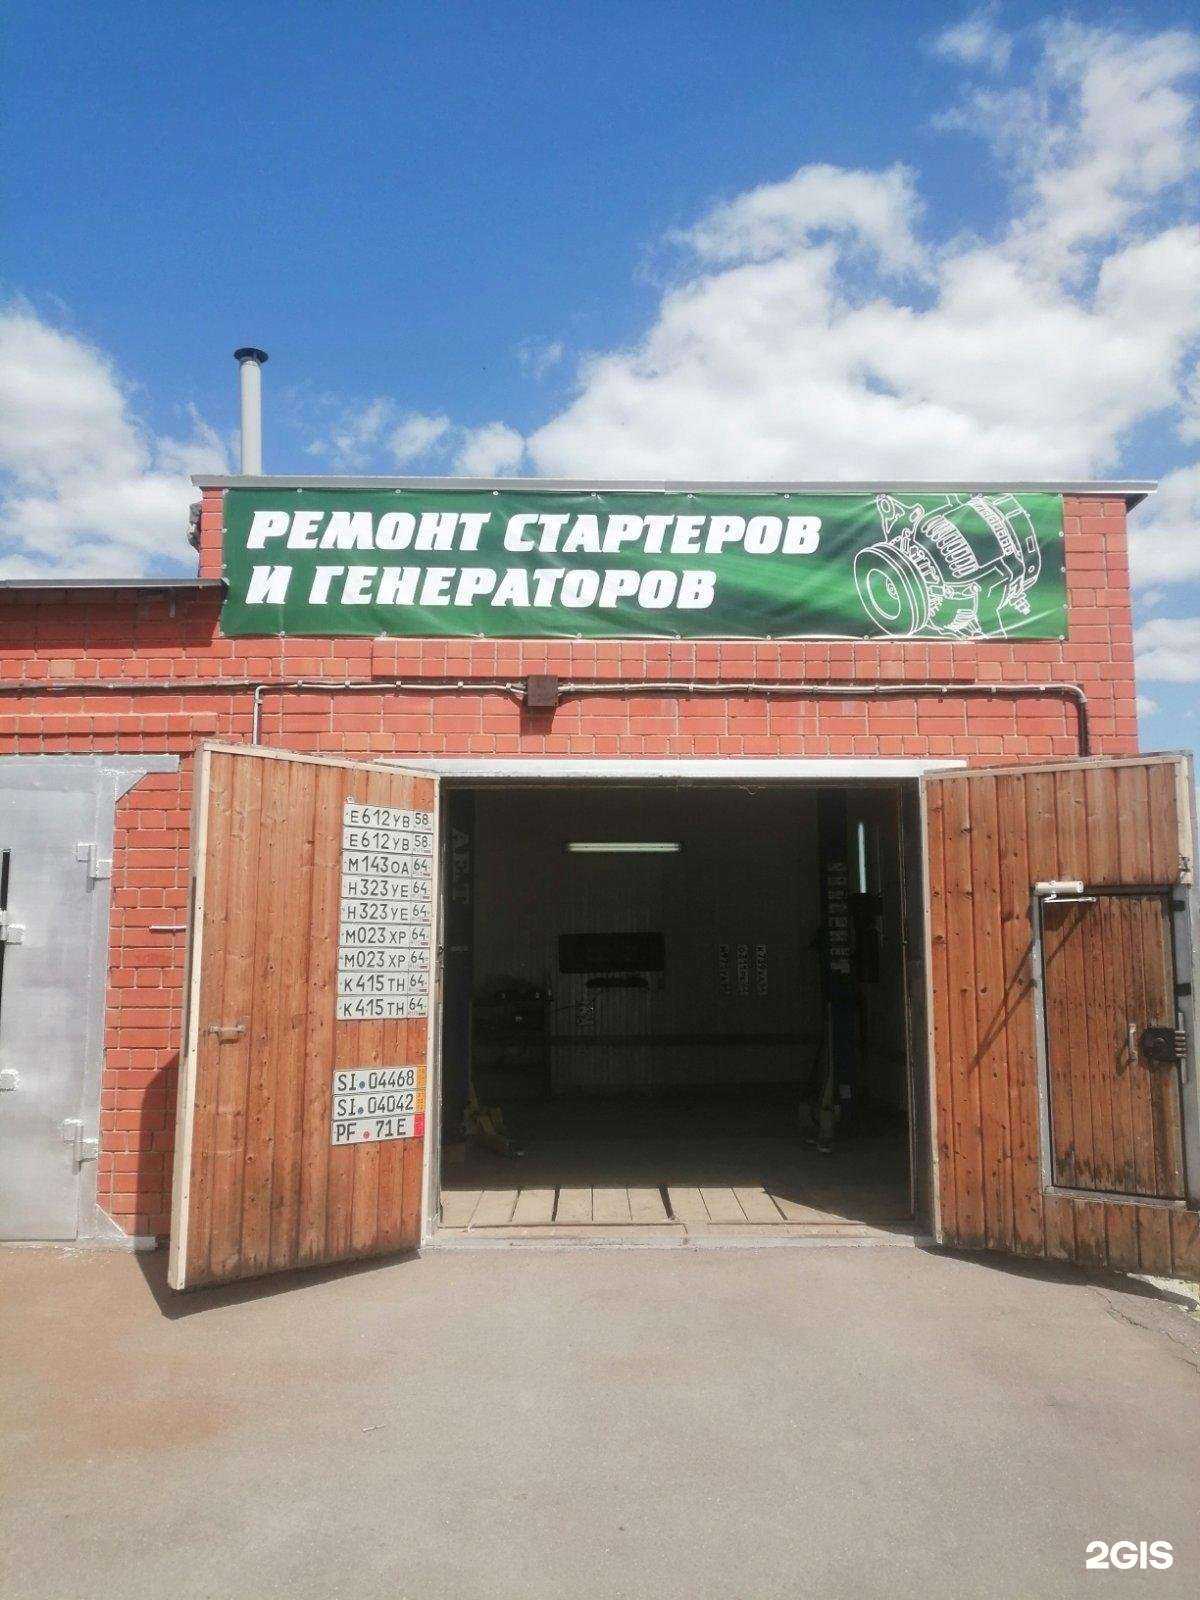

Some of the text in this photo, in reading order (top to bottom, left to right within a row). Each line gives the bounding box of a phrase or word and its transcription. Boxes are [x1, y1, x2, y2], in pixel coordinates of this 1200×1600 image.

[246, 510, 823, 555] РЕМОНТ СТАРТЕРОВ
[245, 565, 718, 609] И ГЕНЕРАТОРОВ
[368, 1069, 415, 1090] 04468
[367, 1093, 414, 1114] 04042
[336, 1118, 407, 1142] PF 71E
